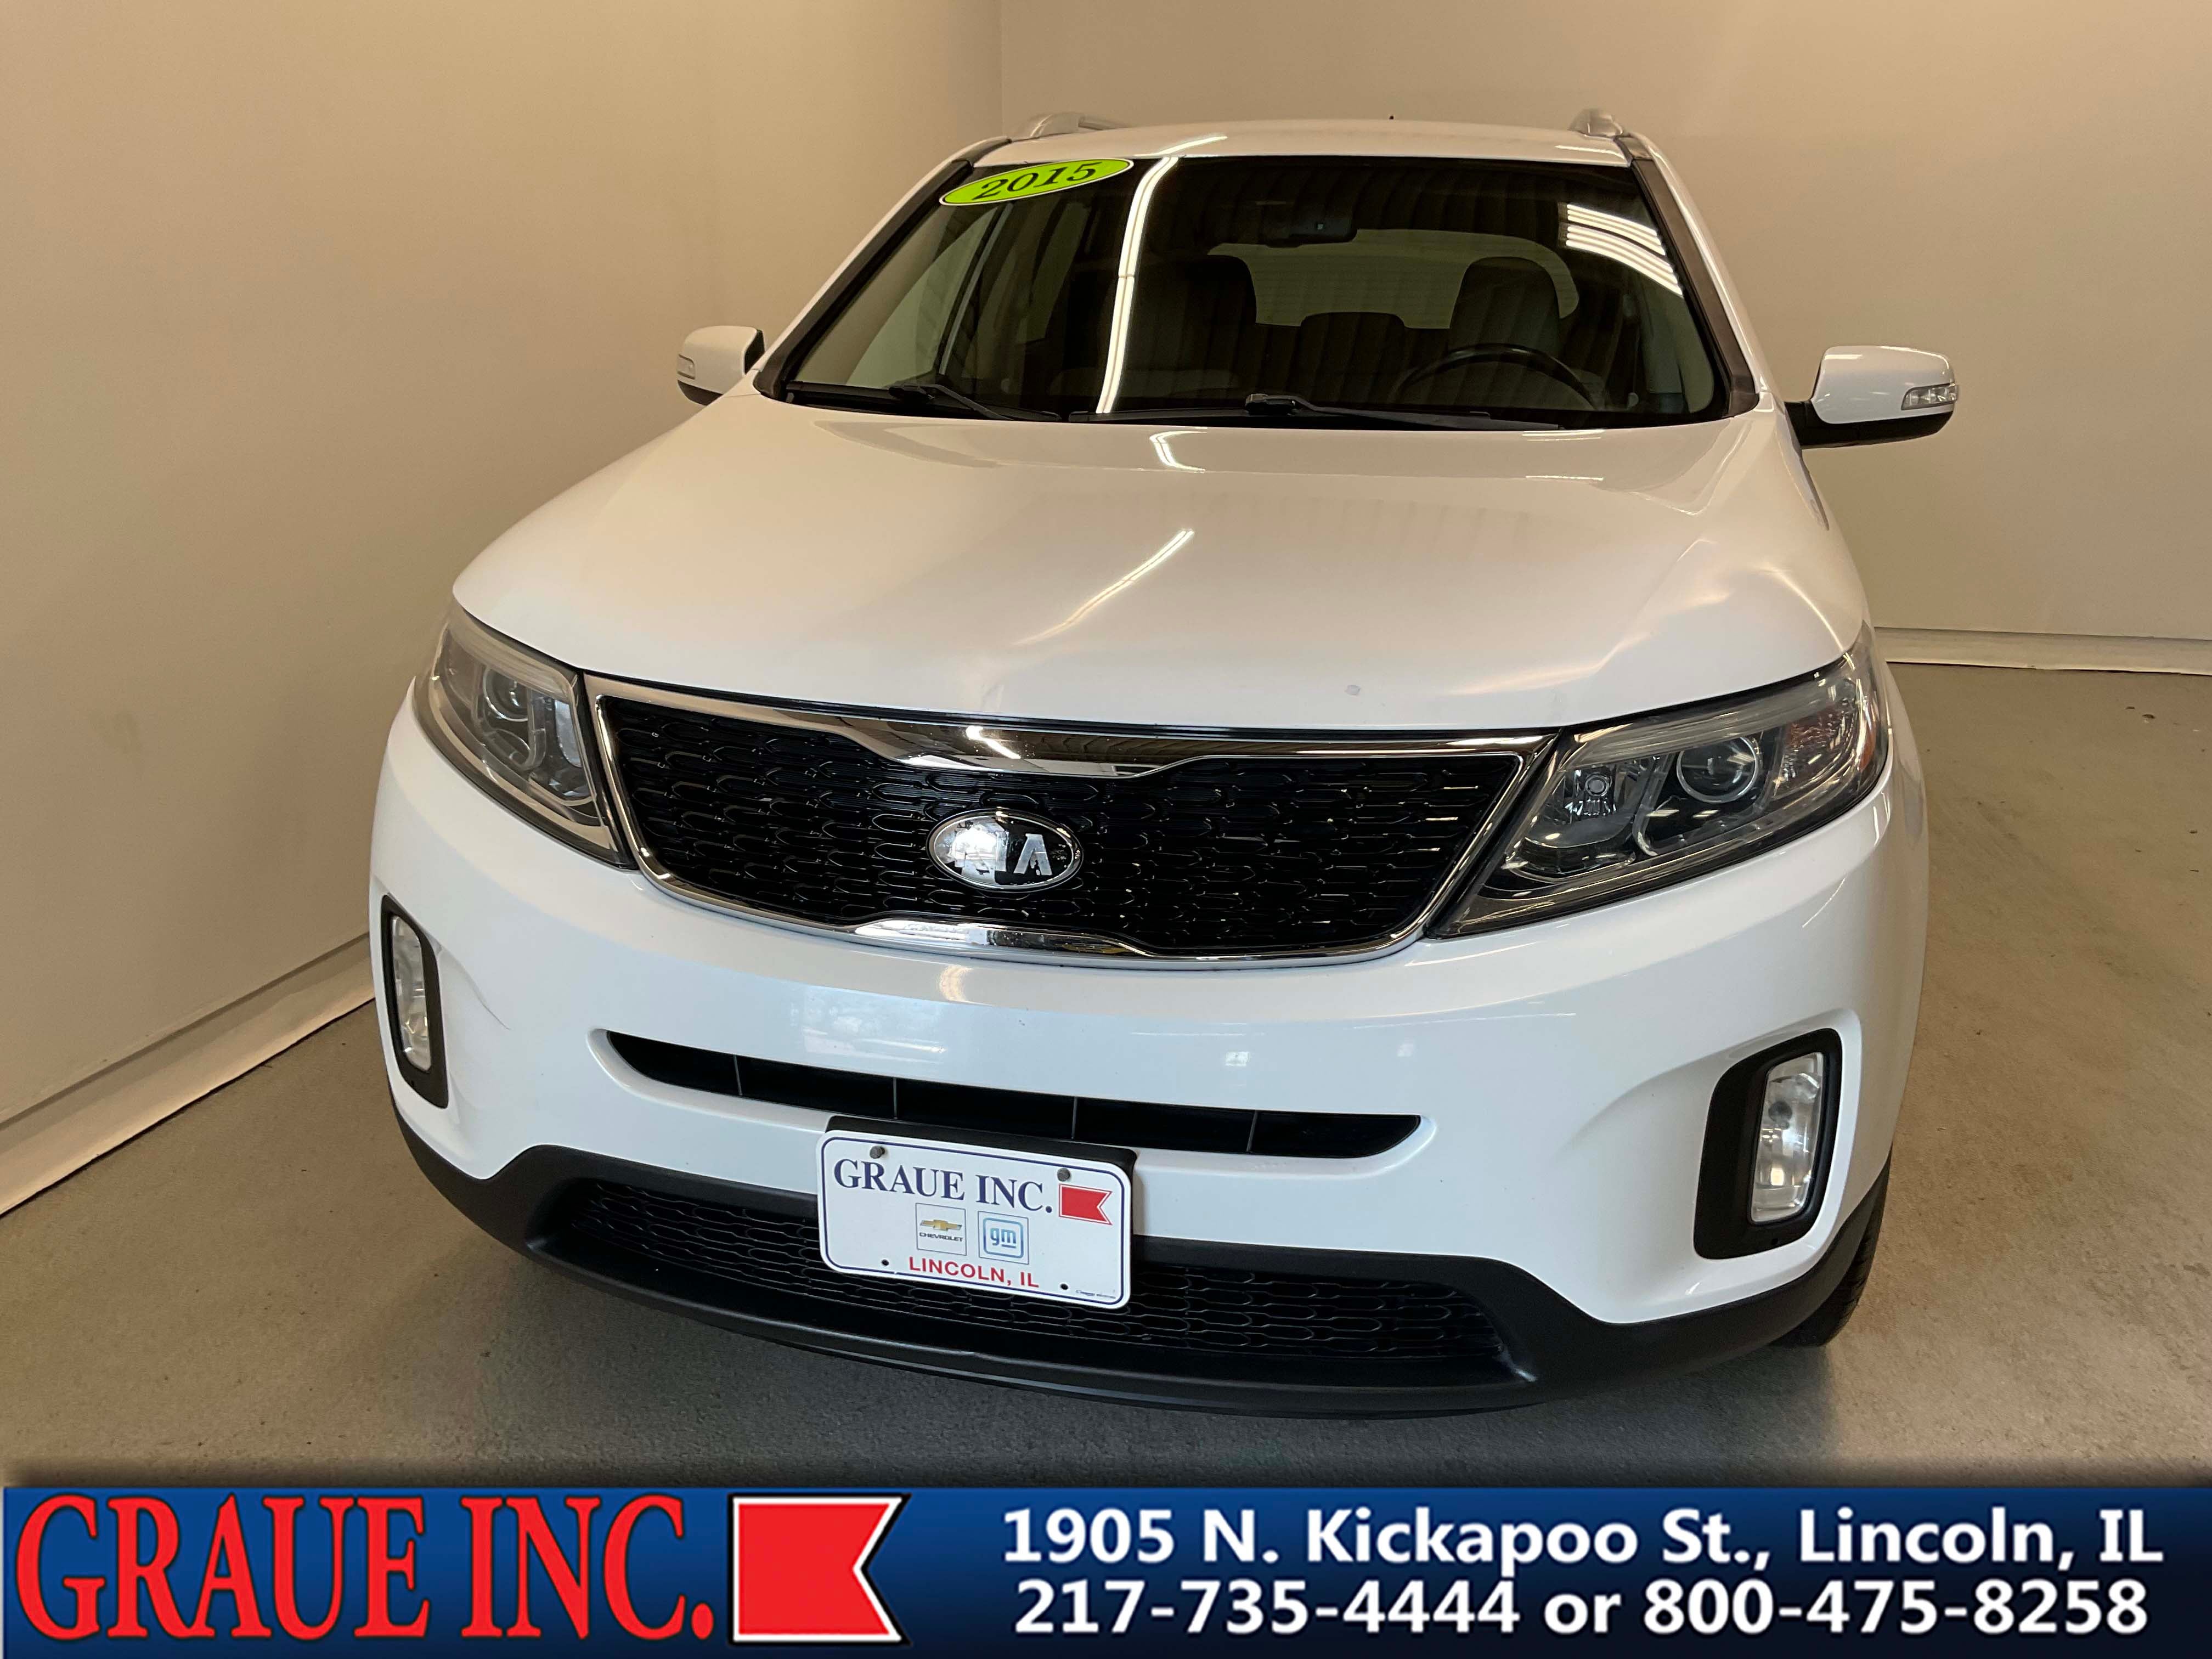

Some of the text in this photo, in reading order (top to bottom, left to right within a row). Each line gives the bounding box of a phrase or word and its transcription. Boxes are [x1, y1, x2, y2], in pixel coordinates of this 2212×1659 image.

[972, 161, 1103, 201] 2015
[834, 1158, 1053, 1214] GRAUE INC.
[919, 1232, 963, 1243] CHEVROLET
[990, 1227, 1017, 1249] gm
[909, 1256, 1040, 1288] LINCOLN, IL
